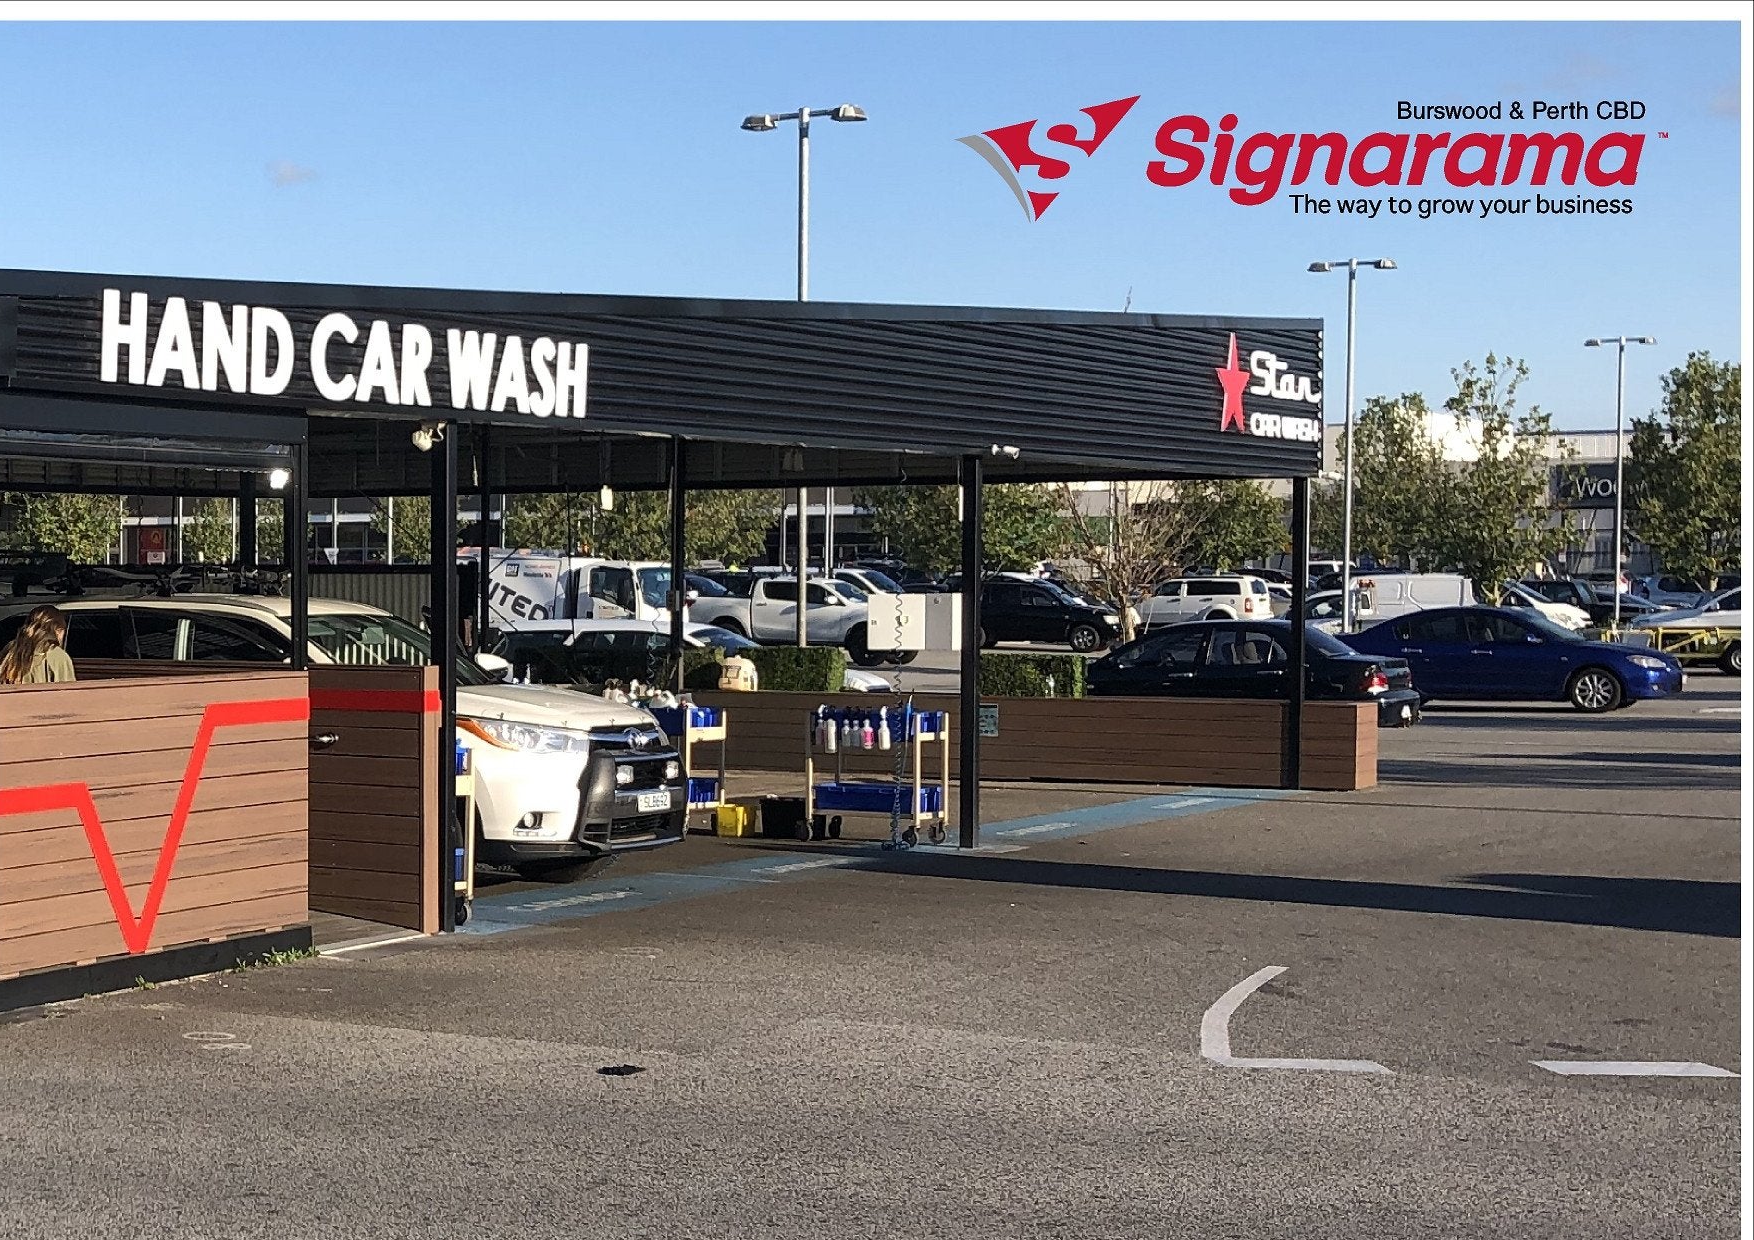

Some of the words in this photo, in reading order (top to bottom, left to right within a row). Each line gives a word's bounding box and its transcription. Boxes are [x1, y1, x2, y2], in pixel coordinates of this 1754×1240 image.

[100, 288, 295, 395] HAND
[310, 312, 433, 406] CAR
[447, 328, 590, 419] WASH
